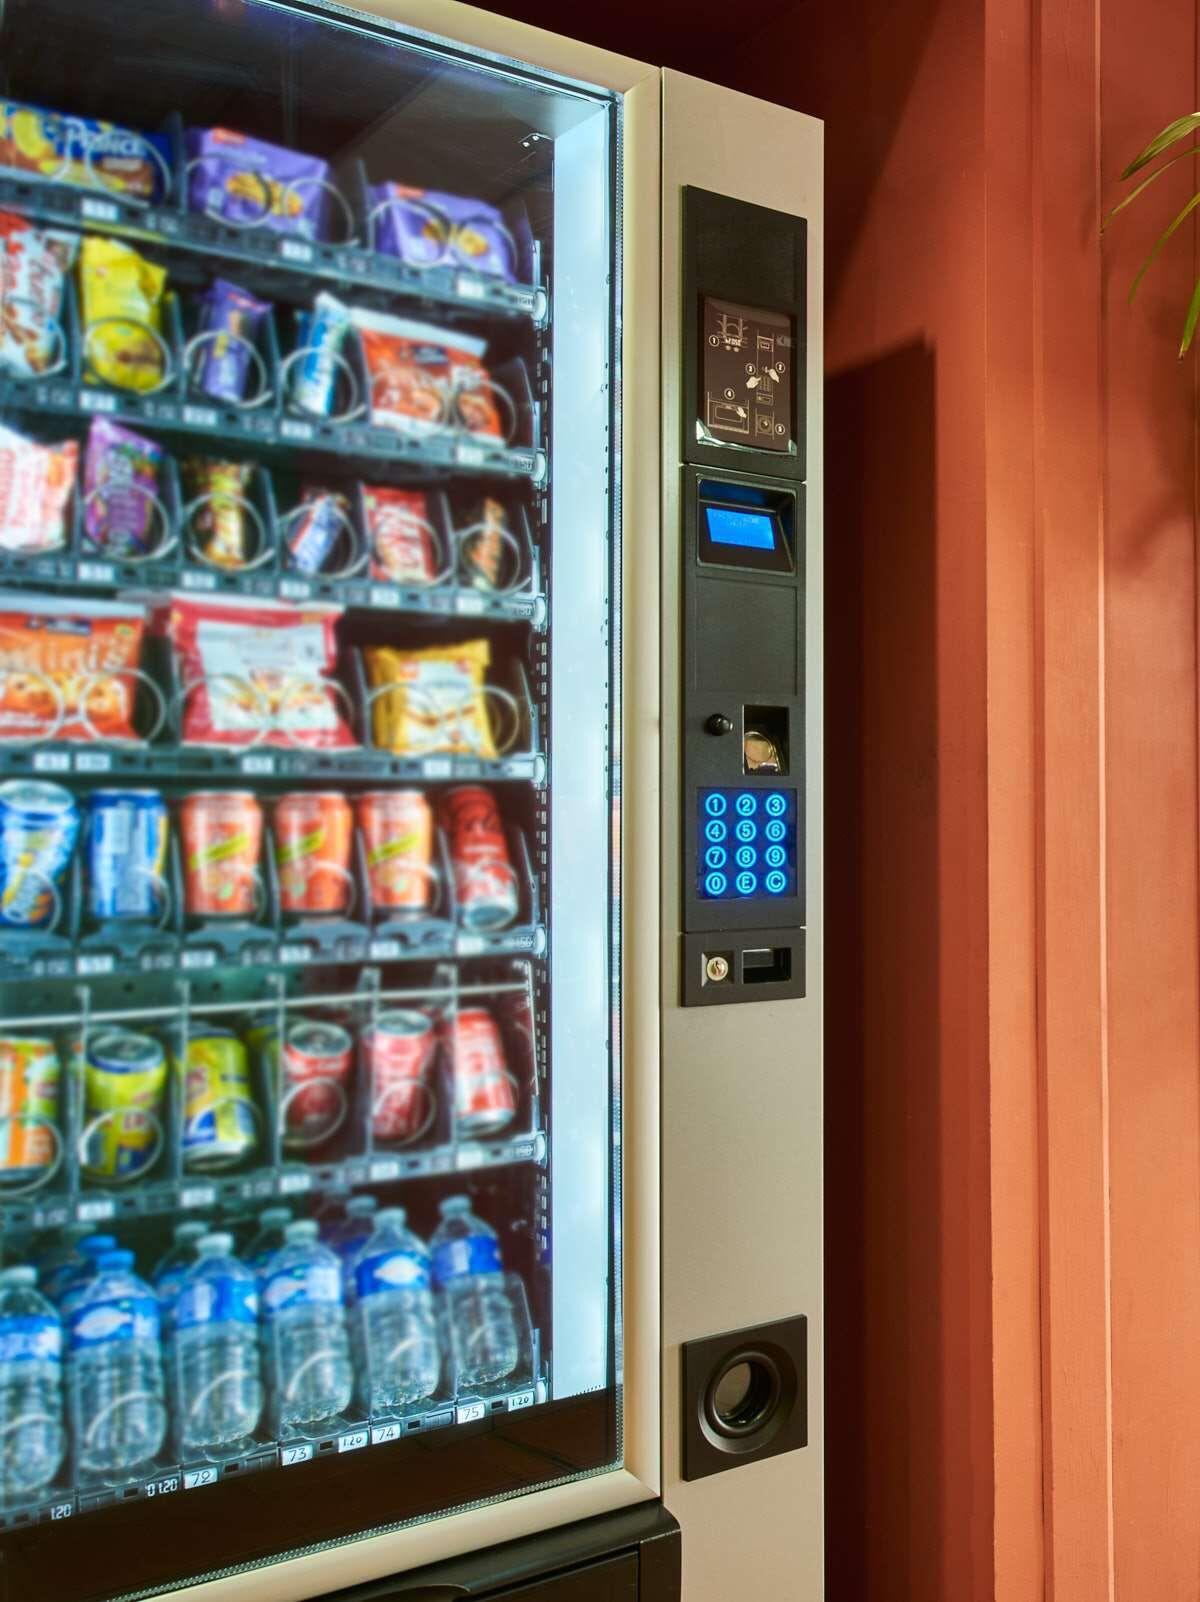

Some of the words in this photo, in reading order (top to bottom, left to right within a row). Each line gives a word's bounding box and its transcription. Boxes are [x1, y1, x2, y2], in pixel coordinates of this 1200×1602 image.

[711, 798, 719, 812] 1
[741, 798, 751, 812] 2
[771, 798, 781, 812] 3
[710, 824, 720, 838] 4
[741, 824, 751, 838] 5
[771, 824, 780, 837] 6
[711, 850, 720, 864] 7
[741, 850, 751, 863] 8
[771, 849, 780, 863] 9
[711, 876, 721, 890] 0
[741, 876, 751, 889] E
[770, 875, 781, 888] C
[464, 1406, 481, 1420] 75
[379, 1426, 394, 1441] 74
[288, 1446, 307, 1462] 73
[191, 1470, 211, 1486] 72
